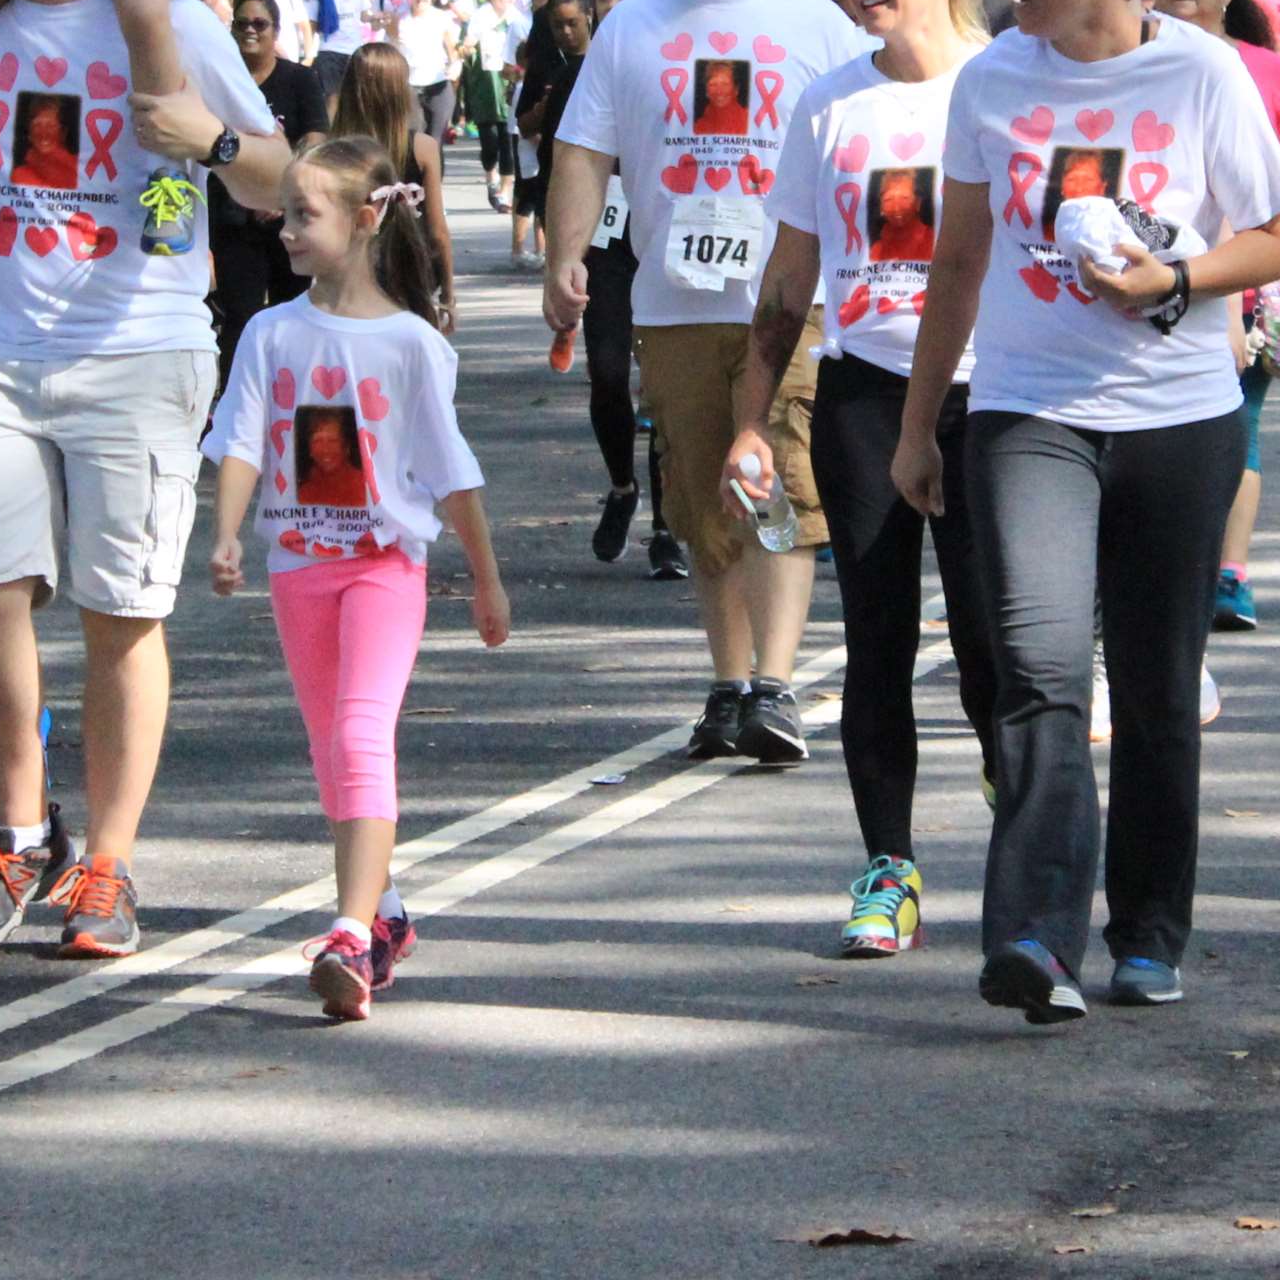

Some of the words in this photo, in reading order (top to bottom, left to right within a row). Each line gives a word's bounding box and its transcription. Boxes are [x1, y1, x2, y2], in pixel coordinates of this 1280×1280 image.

[712, 136, 779, 150] SCHARPENBERG
[33, 189, 120, 205] SCHARPENBERG
[683, 235, 749, 267] 1074
